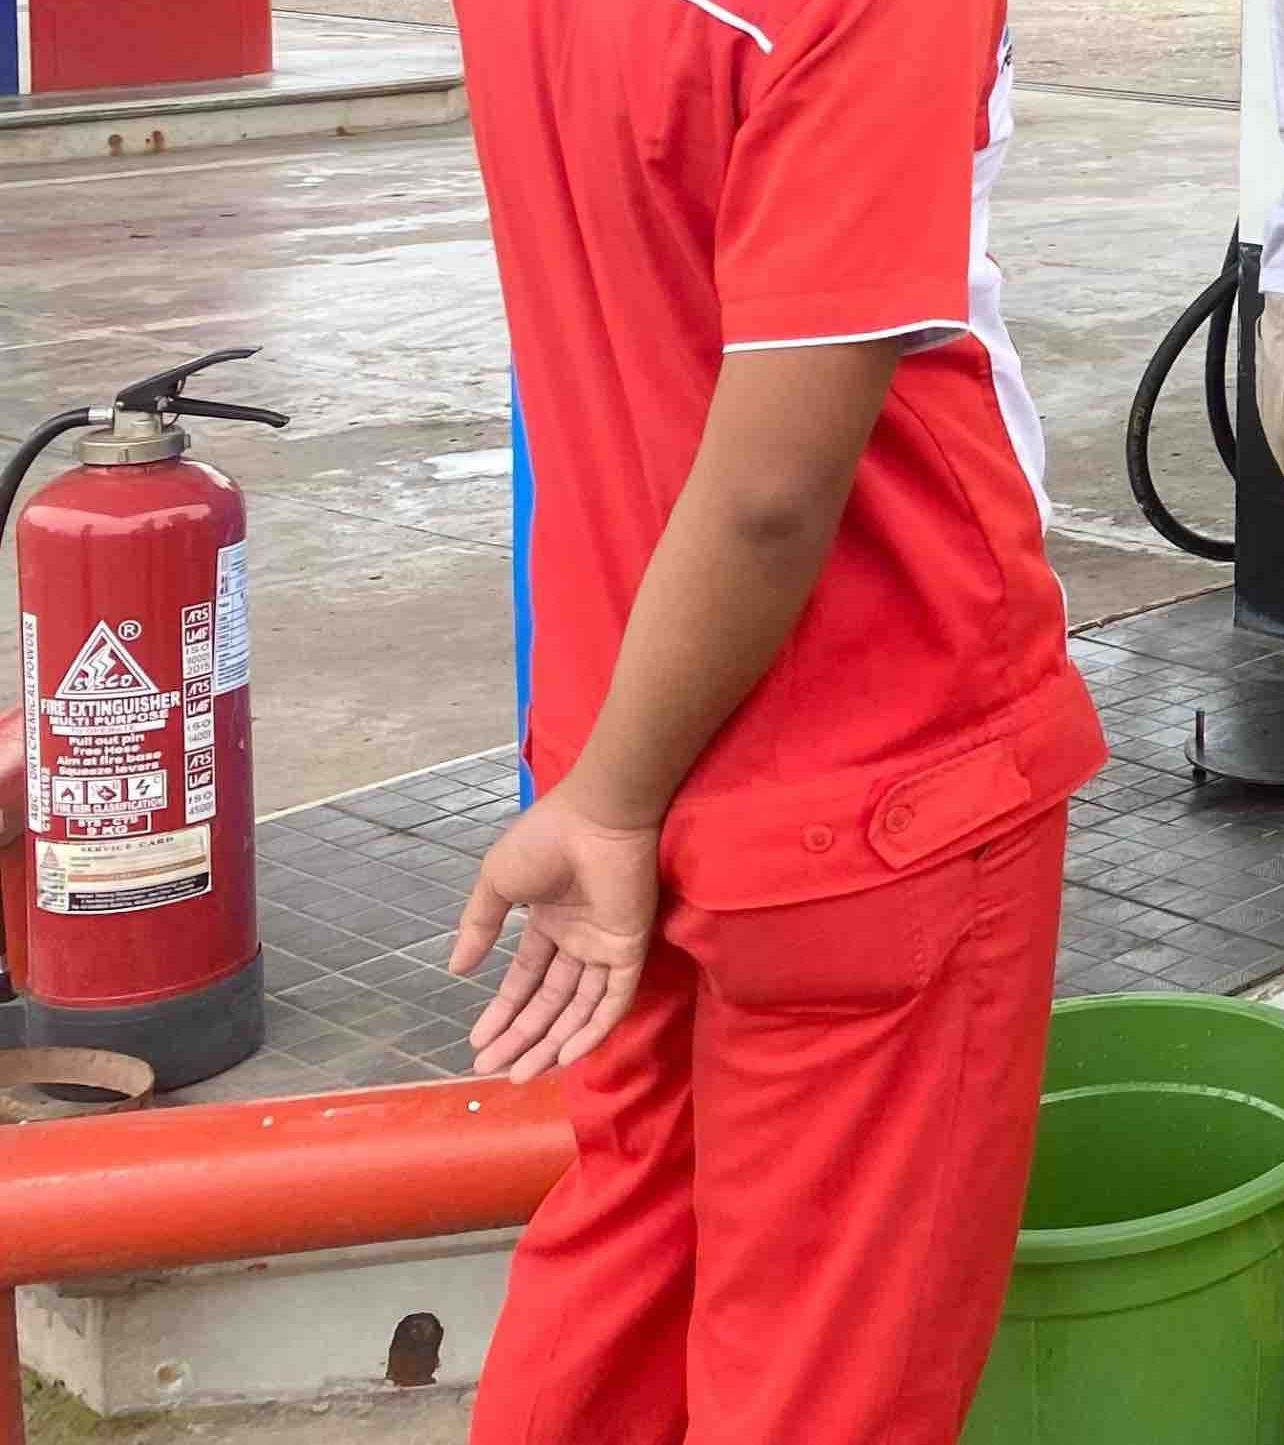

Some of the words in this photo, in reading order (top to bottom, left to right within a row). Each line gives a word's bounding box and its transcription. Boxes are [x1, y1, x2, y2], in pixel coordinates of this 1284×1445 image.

[40, 698, 66, 716] FIRE
[68, 690, 181, 717] EXTINGUISHER
[49, 715, 90, 726] MULTI
[94, 709, 169, 726] PURPOSE
[69, 736, 93, 746] Pull
[94, 736, 119, 746] out
[121, 732, 145, 747] pin
[57, 756, 81, 766] Aim
[82, 756, 98, 766] at
[100, 754, 124, 765] fire
[126, 751, 162, 763] base
[72, 746, 102, 756] Free
[58, 766, 113, 777] Squeeze
[115, 761, 159, 774] levers
